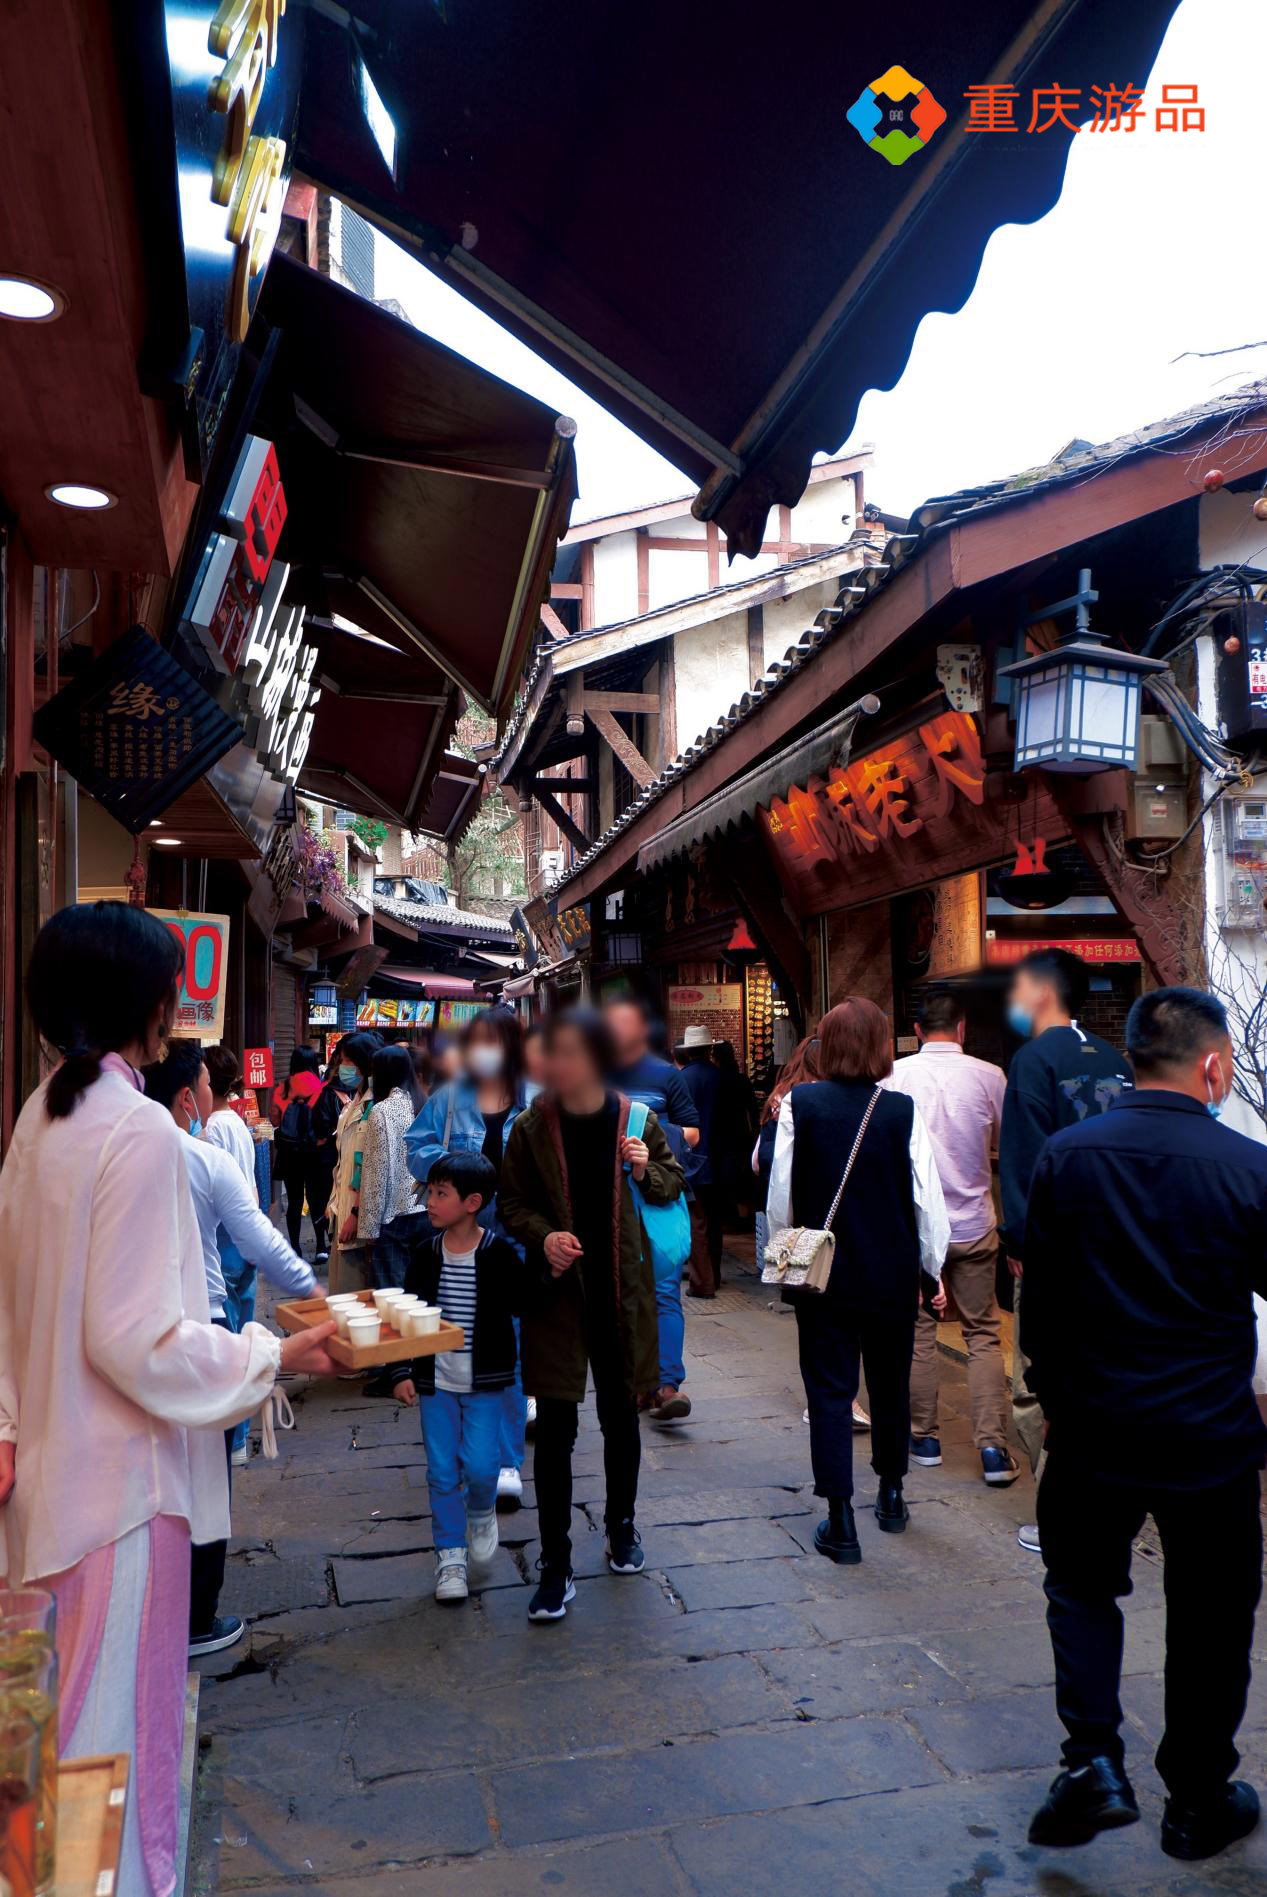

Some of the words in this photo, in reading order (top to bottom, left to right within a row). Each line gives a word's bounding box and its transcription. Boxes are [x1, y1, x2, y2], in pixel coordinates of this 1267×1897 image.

[246, 563, 321, 787] 山城漫画
[106, 681, 165, 720] 缘
[176, 1002, 215, 1021] 画像
[249, 1051, 267, 1086] 包邮
